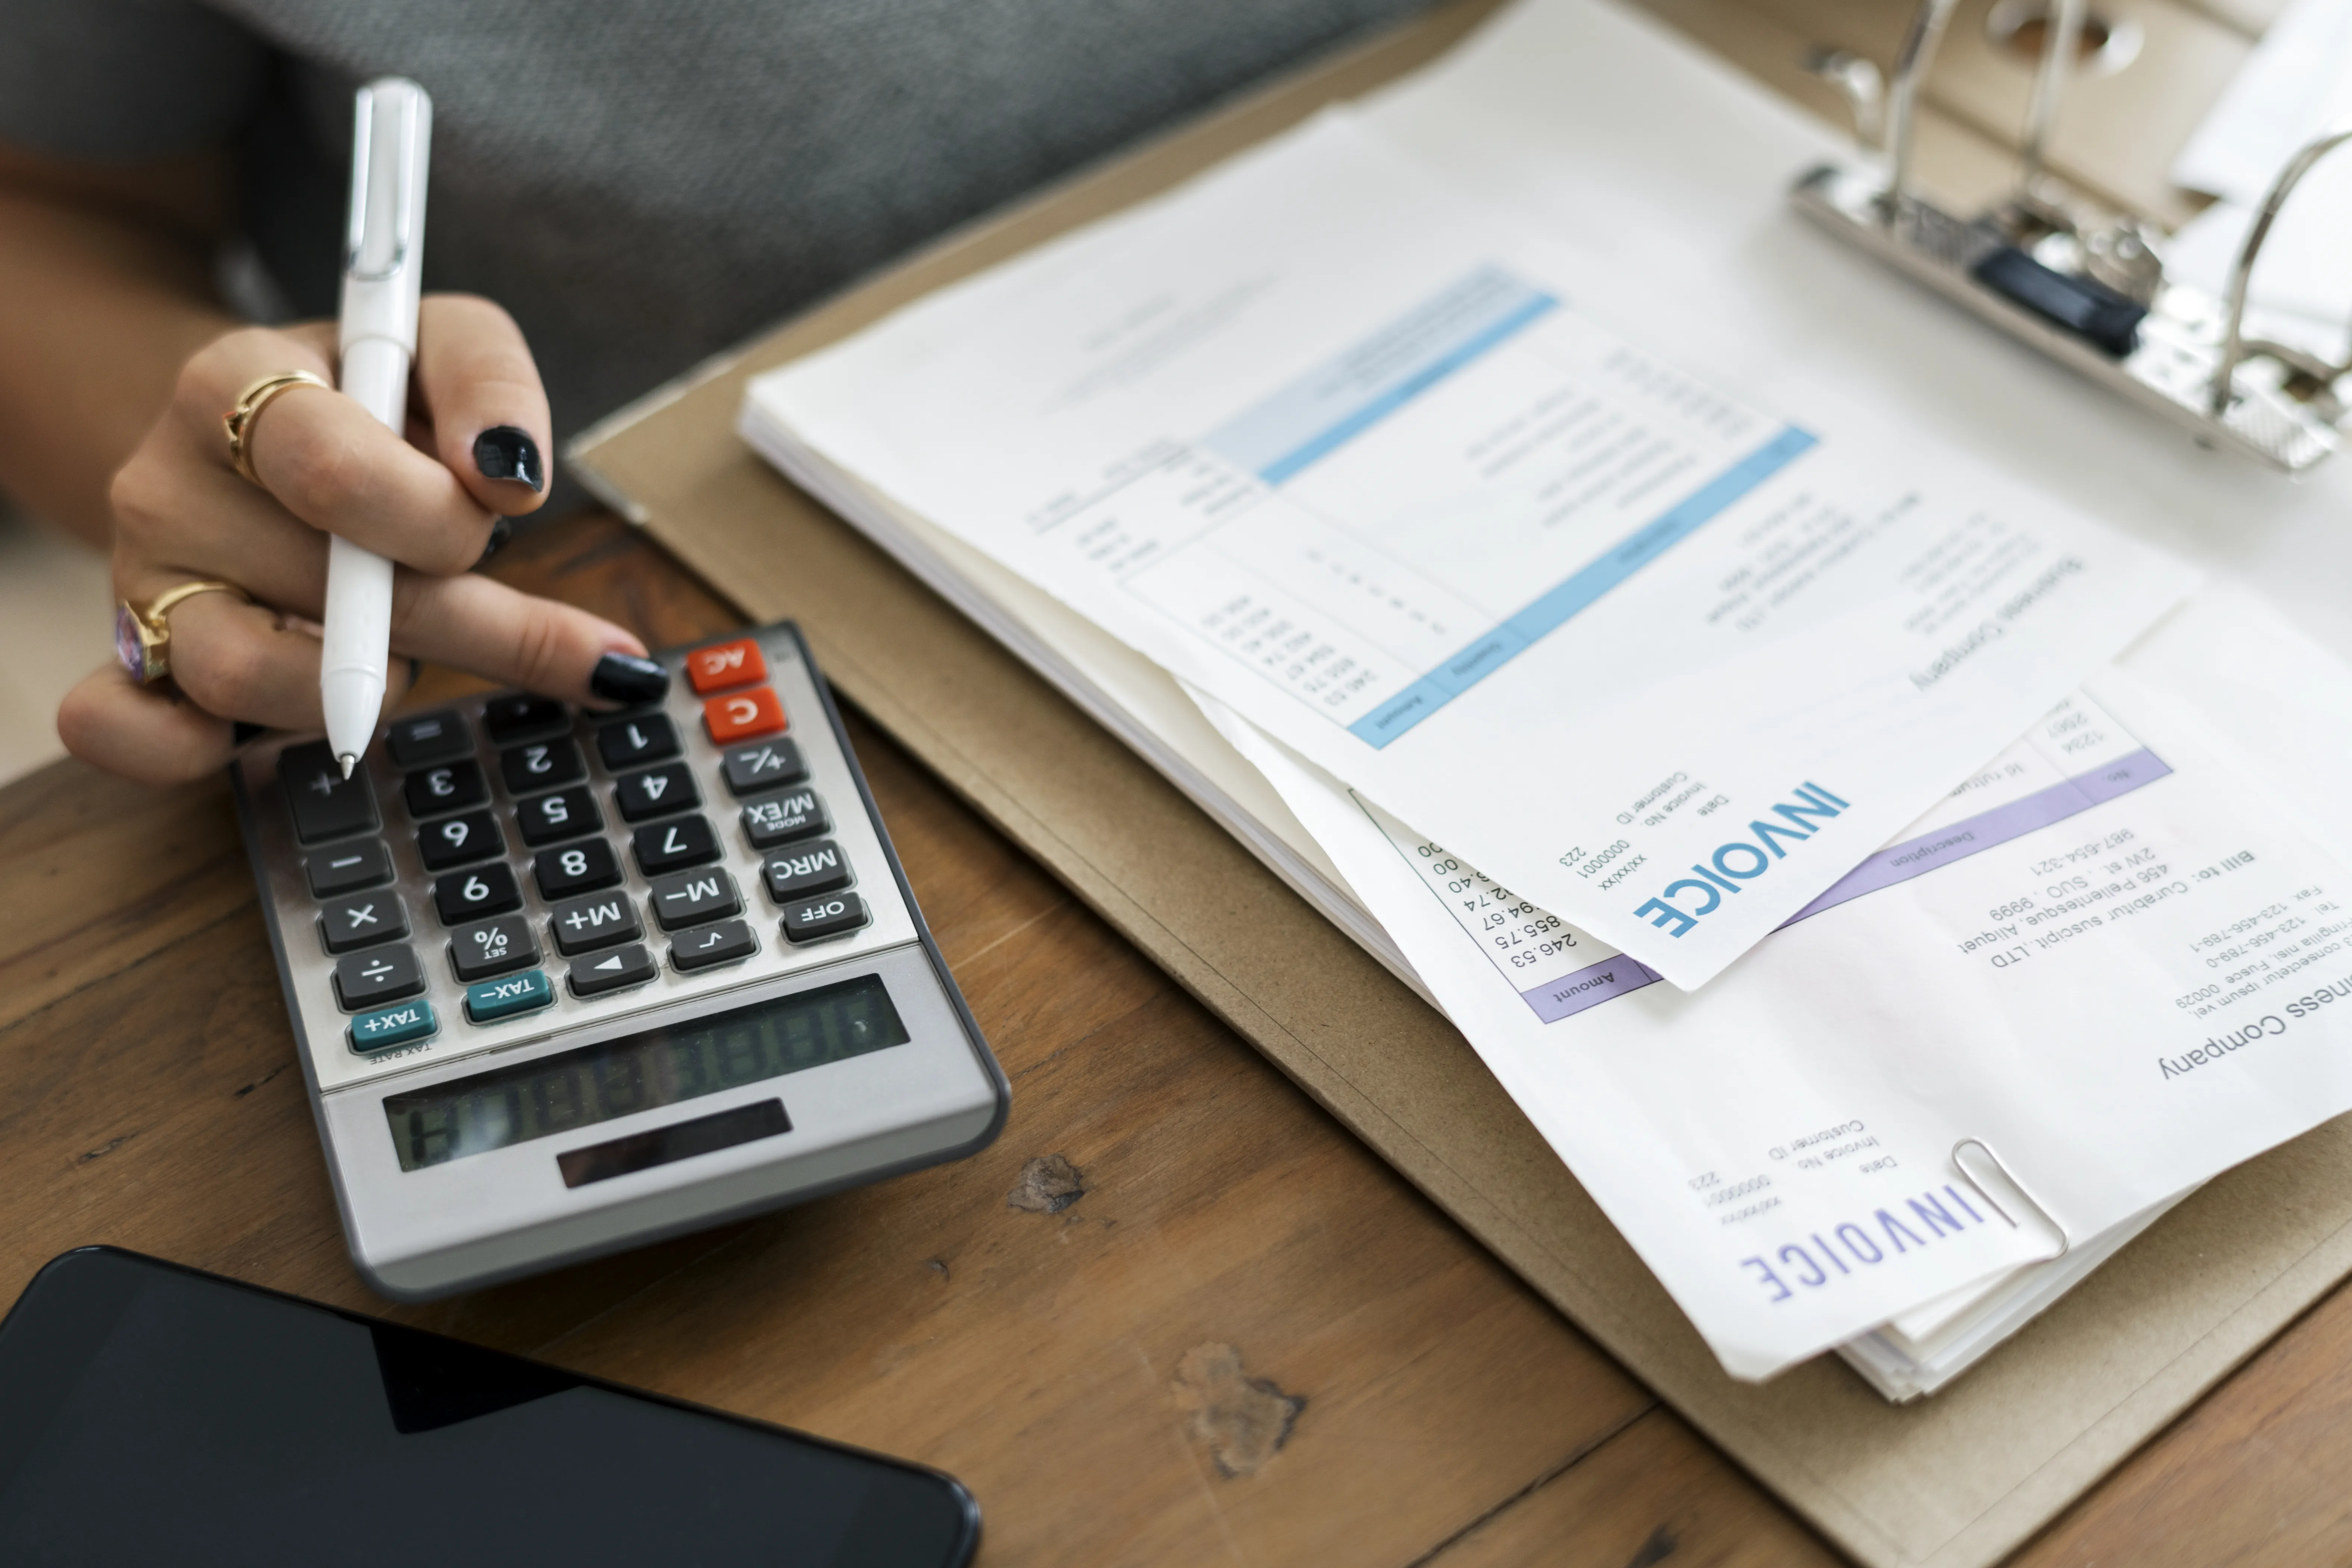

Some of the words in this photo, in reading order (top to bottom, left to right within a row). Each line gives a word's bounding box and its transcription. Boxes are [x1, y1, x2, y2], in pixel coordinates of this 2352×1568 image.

[701, 647, 745, 676] AC
[727, 699, 759, 725] C
[627, 724, 648, 749] 1
[525, 746, 552, 773] 2
[429, 769, 455, 796] 3
[642, 775, 668, 800] 4
[1632, 770, 1689, 813] Customer
[541, 796, 568, 824] 5
[747, 793, 814, 824] M/EX
[1662, 781, 1708, 813] Invoice
[1696, 793, 1730, 816] Date
[766, 815, 806, 831] MODE
[1616, 812, 1635, 825] ID
[442, 821, 469, 847] 6
[663, 827, 687, 854] 7
[1559, 846, 1586, 867] 223
[1576, 840, 1630, 878] 0000001
[1633, 780, 1851, 938] INVOICE
[1889, 830, 1976, 868] Description
[2125, 847, 2156, 868] 2W
[2219, 850, 2255, 871] Bill
[561, 850, 587, 876] 8
[772, 849, 837, 879] MRC
[1597, 854, 1648, 891] xx/xx/xx
[2136, 864, 2168, 883] 456
[2191, 867, 2220, 882] to:
[463, 875, 489, 900] 9
[802, 901, 844, 921] OFF
[1989, 897, 2034, 921] 9999
[2019, 878, 2136, 925] Pellentesque,
[2107, 881, 2188, 921] Curabitur
[566, 902, 622, 930] M+
[1483, 901, 1541, 931] 94.67
[2189, 903, 2288, 953] 123-456-789-1
[474, 927, 508, 950] %
[1495, 915, 1561, 949] 855.75
[1957, 923, 2018, 954] Aliquet
[2206, 917, 2306, 968] 123-456-789-0
[485, 947, 507, 959] SET
[1511, 933, 1577, 968] 246.53
[2225, 960, 2270, 984] Fusce
[2263, 942, 2341, 986] consectetur
[1553, 972, 1615, 1002] Amount
[2175, 984, 2220, 1009] 00029
[2216, 982, 2262, 1006] ipsum
[365, 1009, 421, 1032] TAX+
[370, 1051, 403, 1065] RATE
[407, 1043, 433, 1055] TAX
[2158, 1015, 2286, 1080] Company
[1790, 1120, 1864, 1151] Customer
[1823, 1135, 1880, 1160] Invoice
[1768, 1146, 1789, 1161] ID
[1858, 1155, 1898, 1173] Date
[1739, 1184, 1984, 1303] INVOICE
